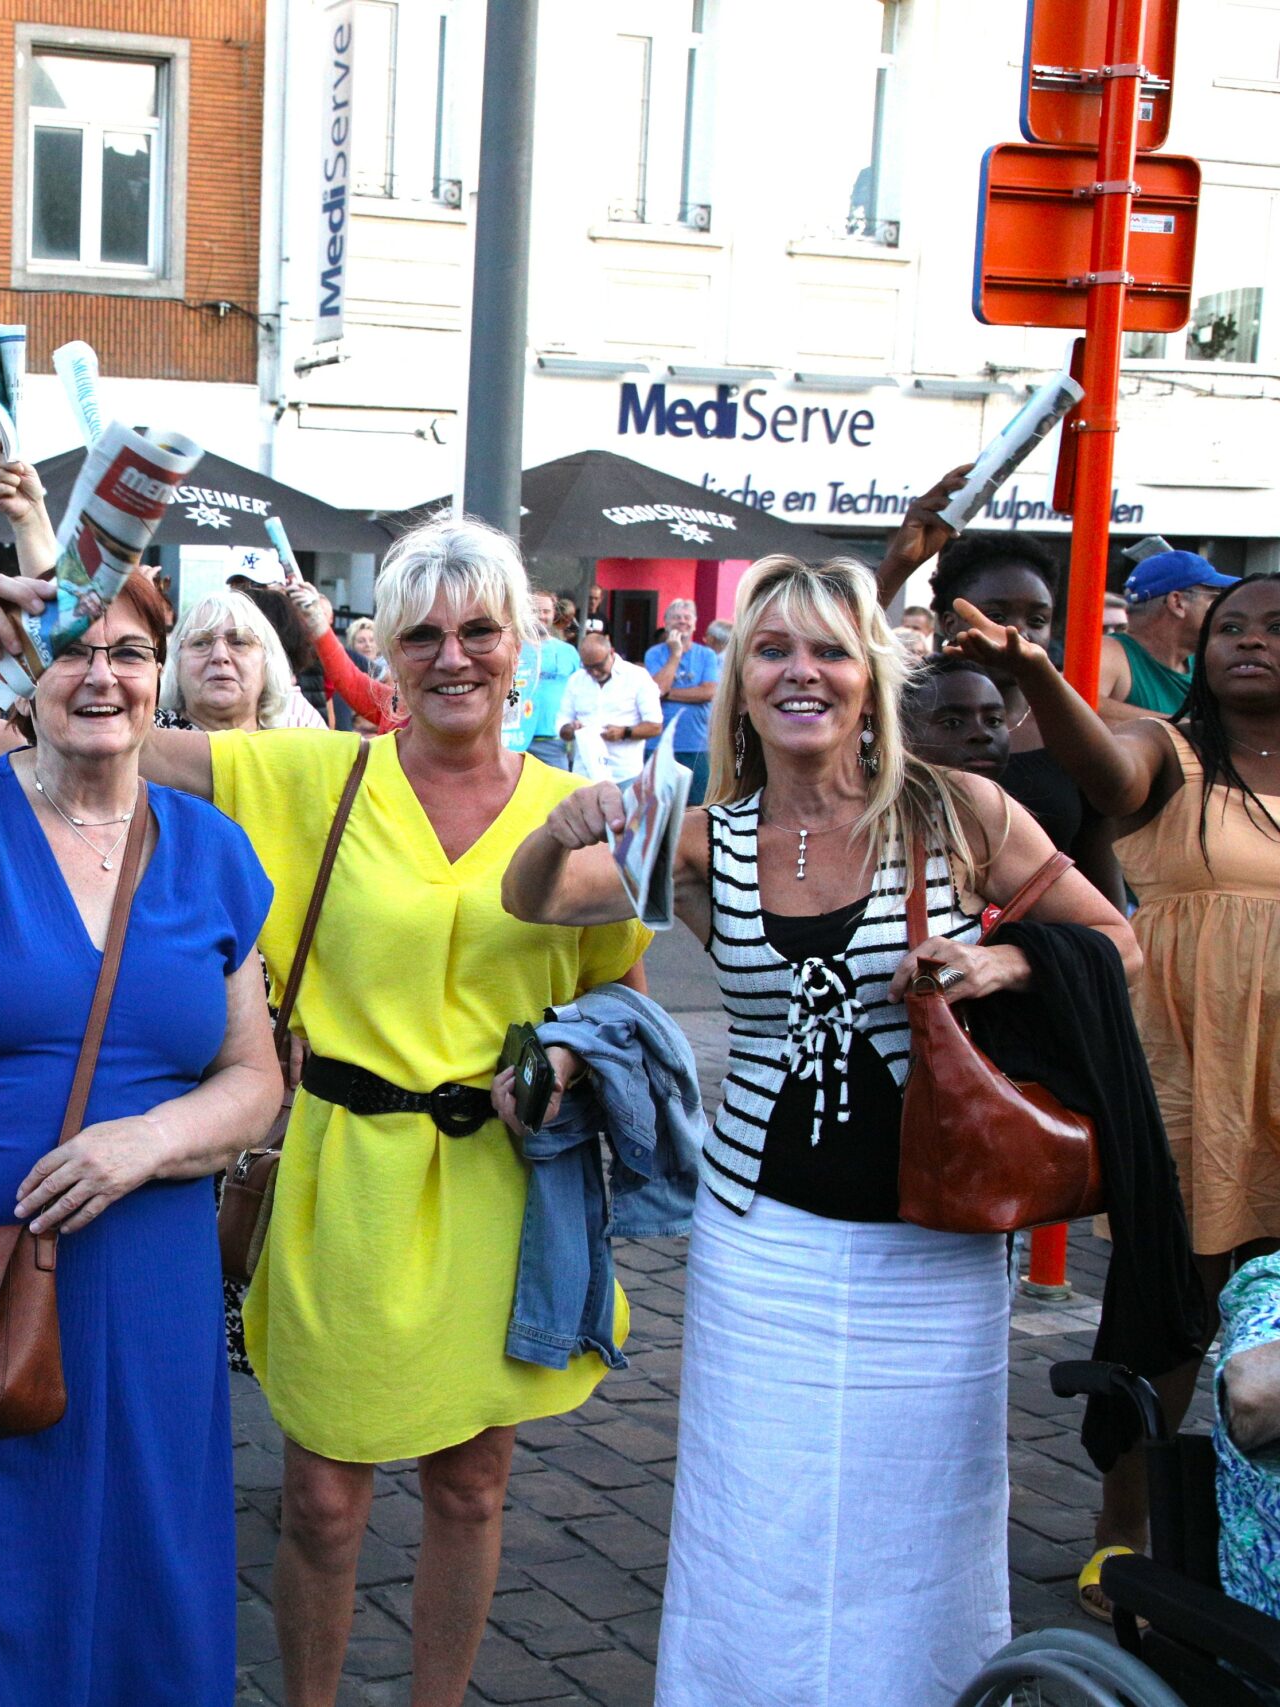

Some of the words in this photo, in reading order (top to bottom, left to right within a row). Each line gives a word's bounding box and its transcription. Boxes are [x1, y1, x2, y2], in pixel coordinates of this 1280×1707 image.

[319, 22, 352, 317] MediServe
[618, 382, 875, 447] MediServe
[602, 504, 737, 530] GEROLSTEINER
[783, 491, 816, 513] en
[827, 479, 918, 514] Techni
